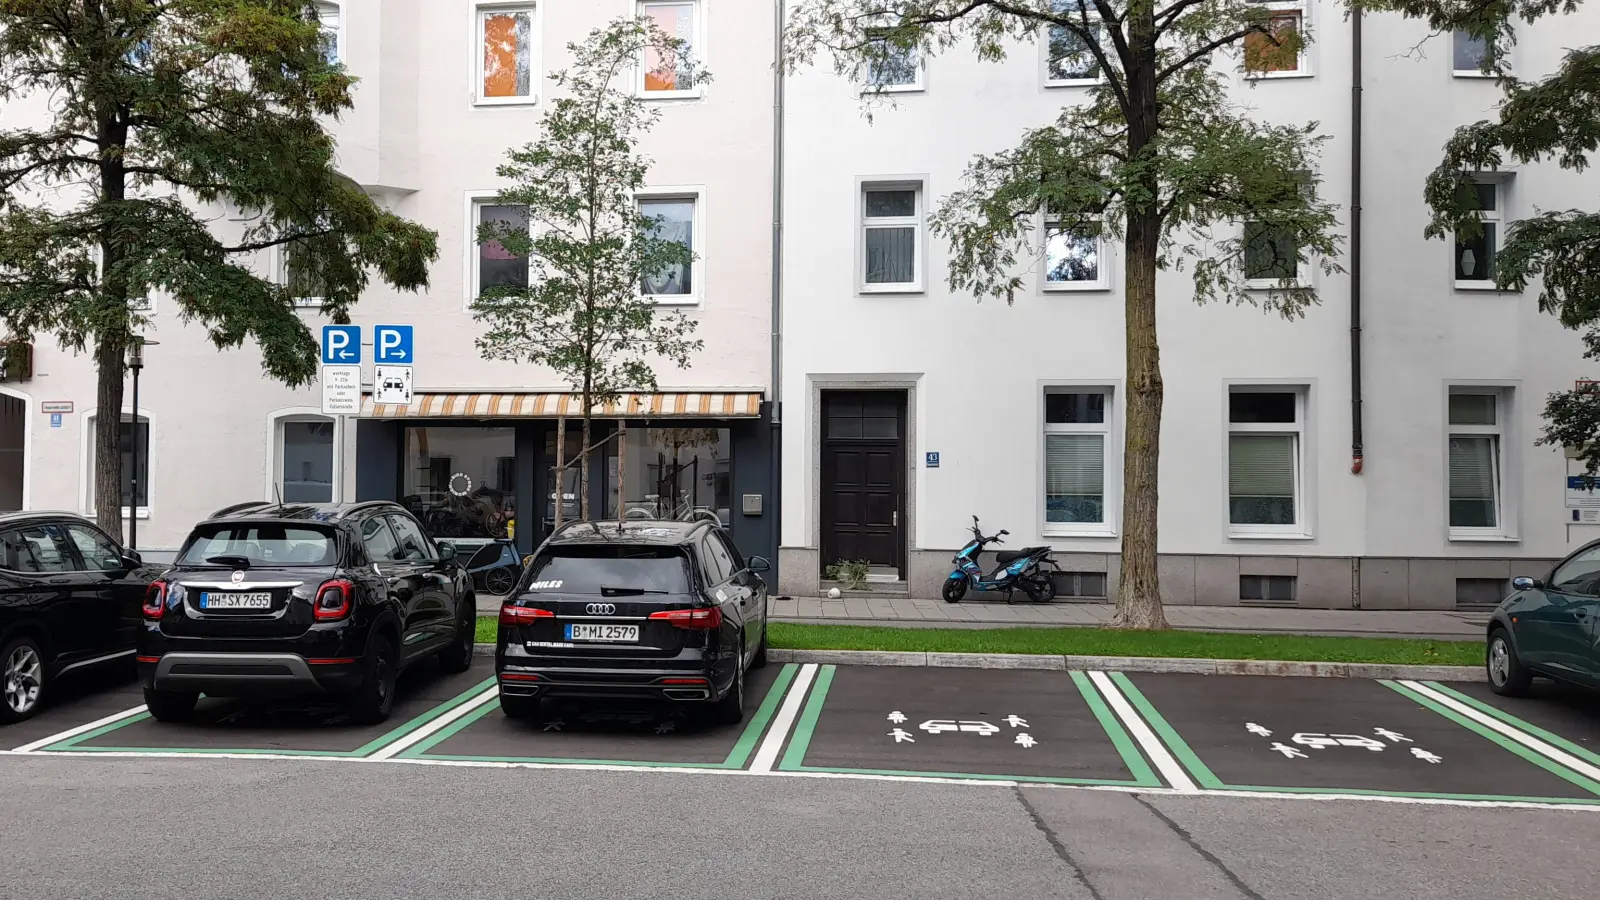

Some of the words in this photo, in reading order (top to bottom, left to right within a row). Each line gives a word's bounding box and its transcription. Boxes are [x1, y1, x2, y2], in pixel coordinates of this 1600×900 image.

[328, 330, 349, 359] P
[380, 330, 401, 358] P
[529, 580, 563, 590] MILES
[208, 595, 220, 606] HH
[228, 595, 241, 606] SX
[574, 626, 580, 637] B
[606, 627, 636, 638] 2579
